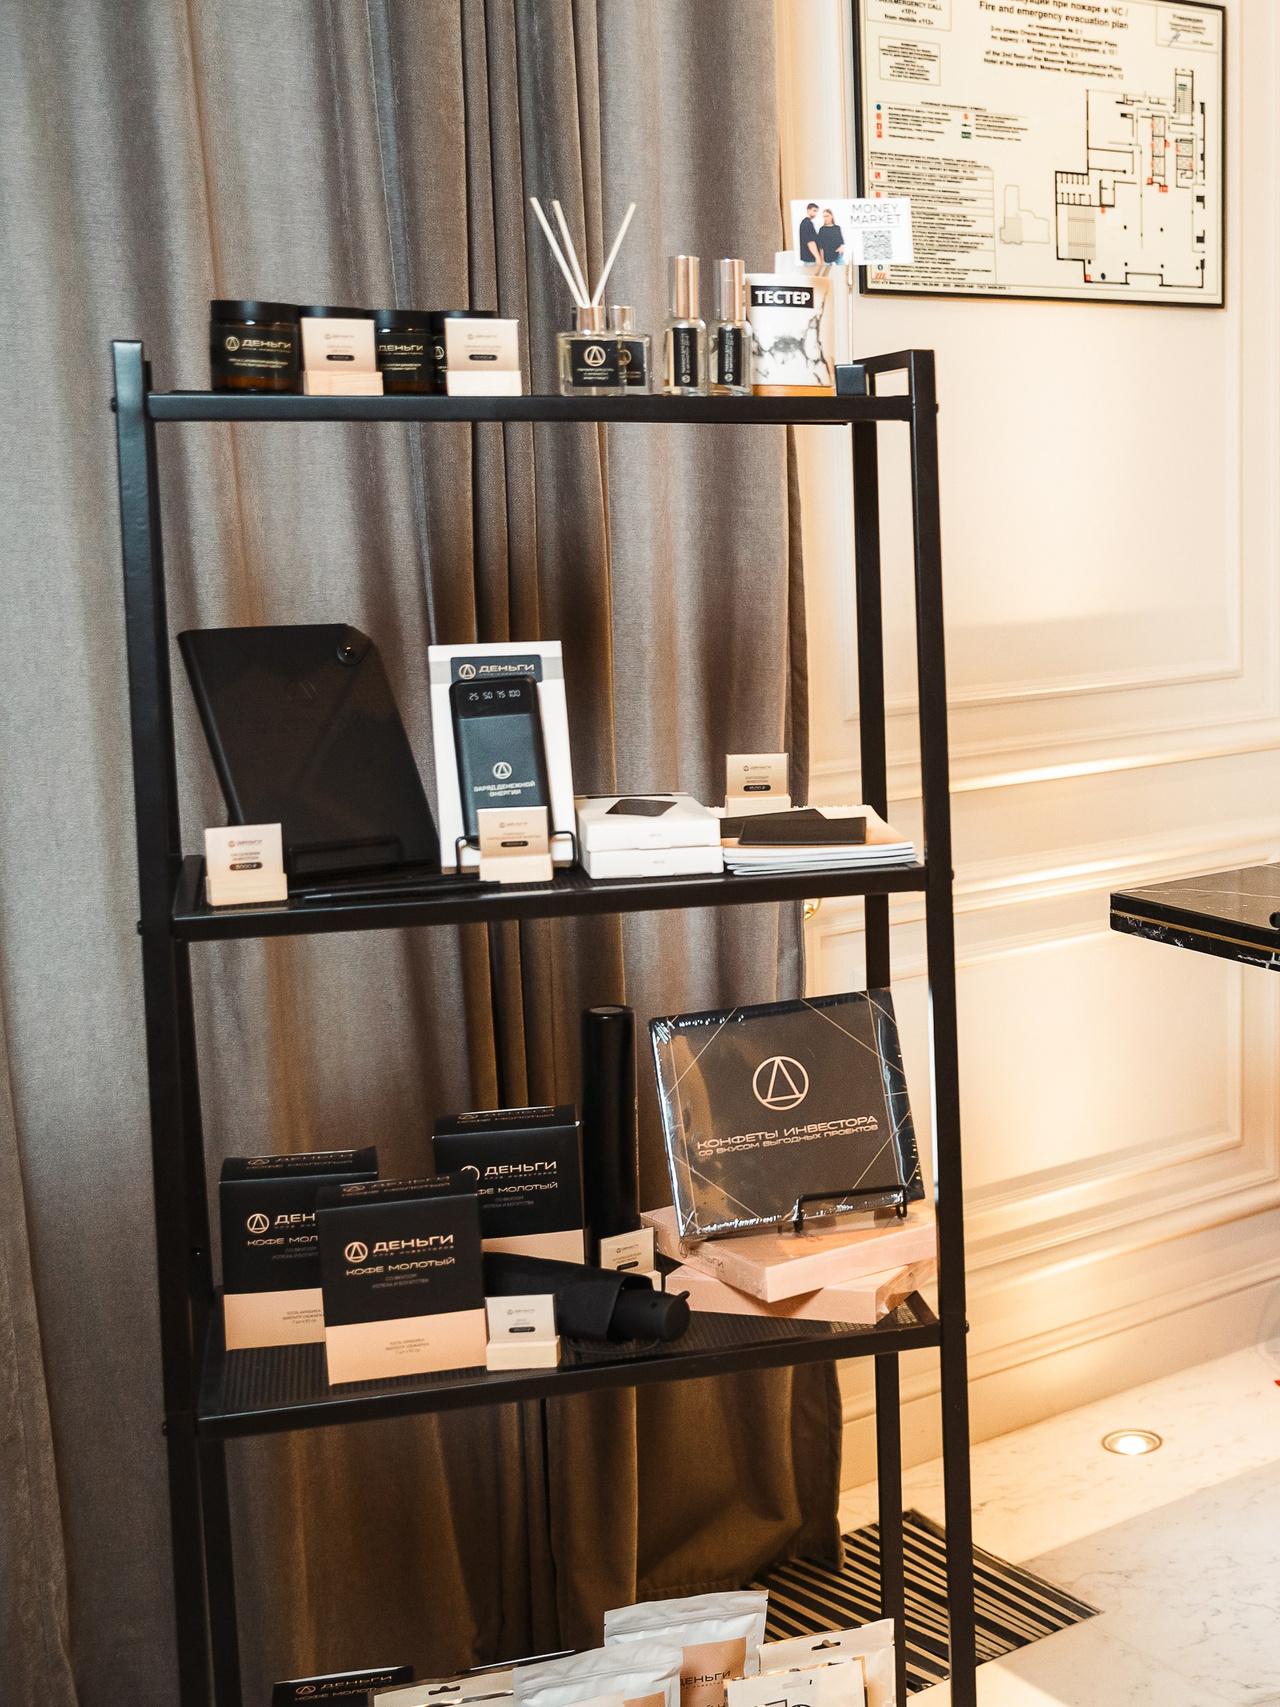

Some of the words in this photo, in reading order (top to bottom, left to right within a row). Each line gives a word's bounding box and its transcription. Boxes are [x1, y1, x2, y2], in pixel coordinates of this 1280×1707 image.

[979, 1, 996, 11] Fire
[999, 5, 1015, 14] and
[1017, 8, 1063, 22] emergency
[1065, 15, 1110, 26] evacuation
[1111, 20, 1129, 29] plan
[851, 203, 899, 214] MONEY
[850, 213, 902, 224] MARKET
[754, 290, 811, 305] ТЕСТЕР
[241, 339, 291, 349] ДЕНЬГИ
[378, 344, 424, 352] ДЕНЬГИ
[478, 663, 535, 674] ДЕНЬГИ
[469, 692, 479, 701] 25
[483, 691, 493, 700] 50
[496, 690, 506, 699] 75
[508, 689, 521, 698] 100
[473, 785, 497, 793] ЗАРЯД
[497, 780, 536, 791] ДЕНЕЖНОЙ
[489, 789, 521, 797] ЭНЕРГИИ
[697, 1130, 779, 1150] КОНФЕТЫ
[783, 1115, 879, 1137] ИНВЕСТОРА
[698, 1149, 714, 1157] СО
[717, 1142, 760, 1154] ВКУСОМ
[762, 1133, 822, 1148] ВЫГОДНЫХ
[824, 1124, 879, 1138] ПРОЕКТОВ
[484, 1161, 557, 1177] ДЕНЬГИ
[477, 1187, 494, 1195] ФЕ
[498, 1181, 558, 1194] МОЛОТЫЙ
[274, 1213, 316, 1226] ДЕН
[247, 1237, 285, 1246] КОФЕ
[373, 1234, 454, 1254] ДЕНЬГИ
[346, 1266, 384, 1276] КОФЕ
[388, 1256, 456, 1272] МОЛОТЫЙ
[332, 1687, 377, 1697] МОЛОТ
